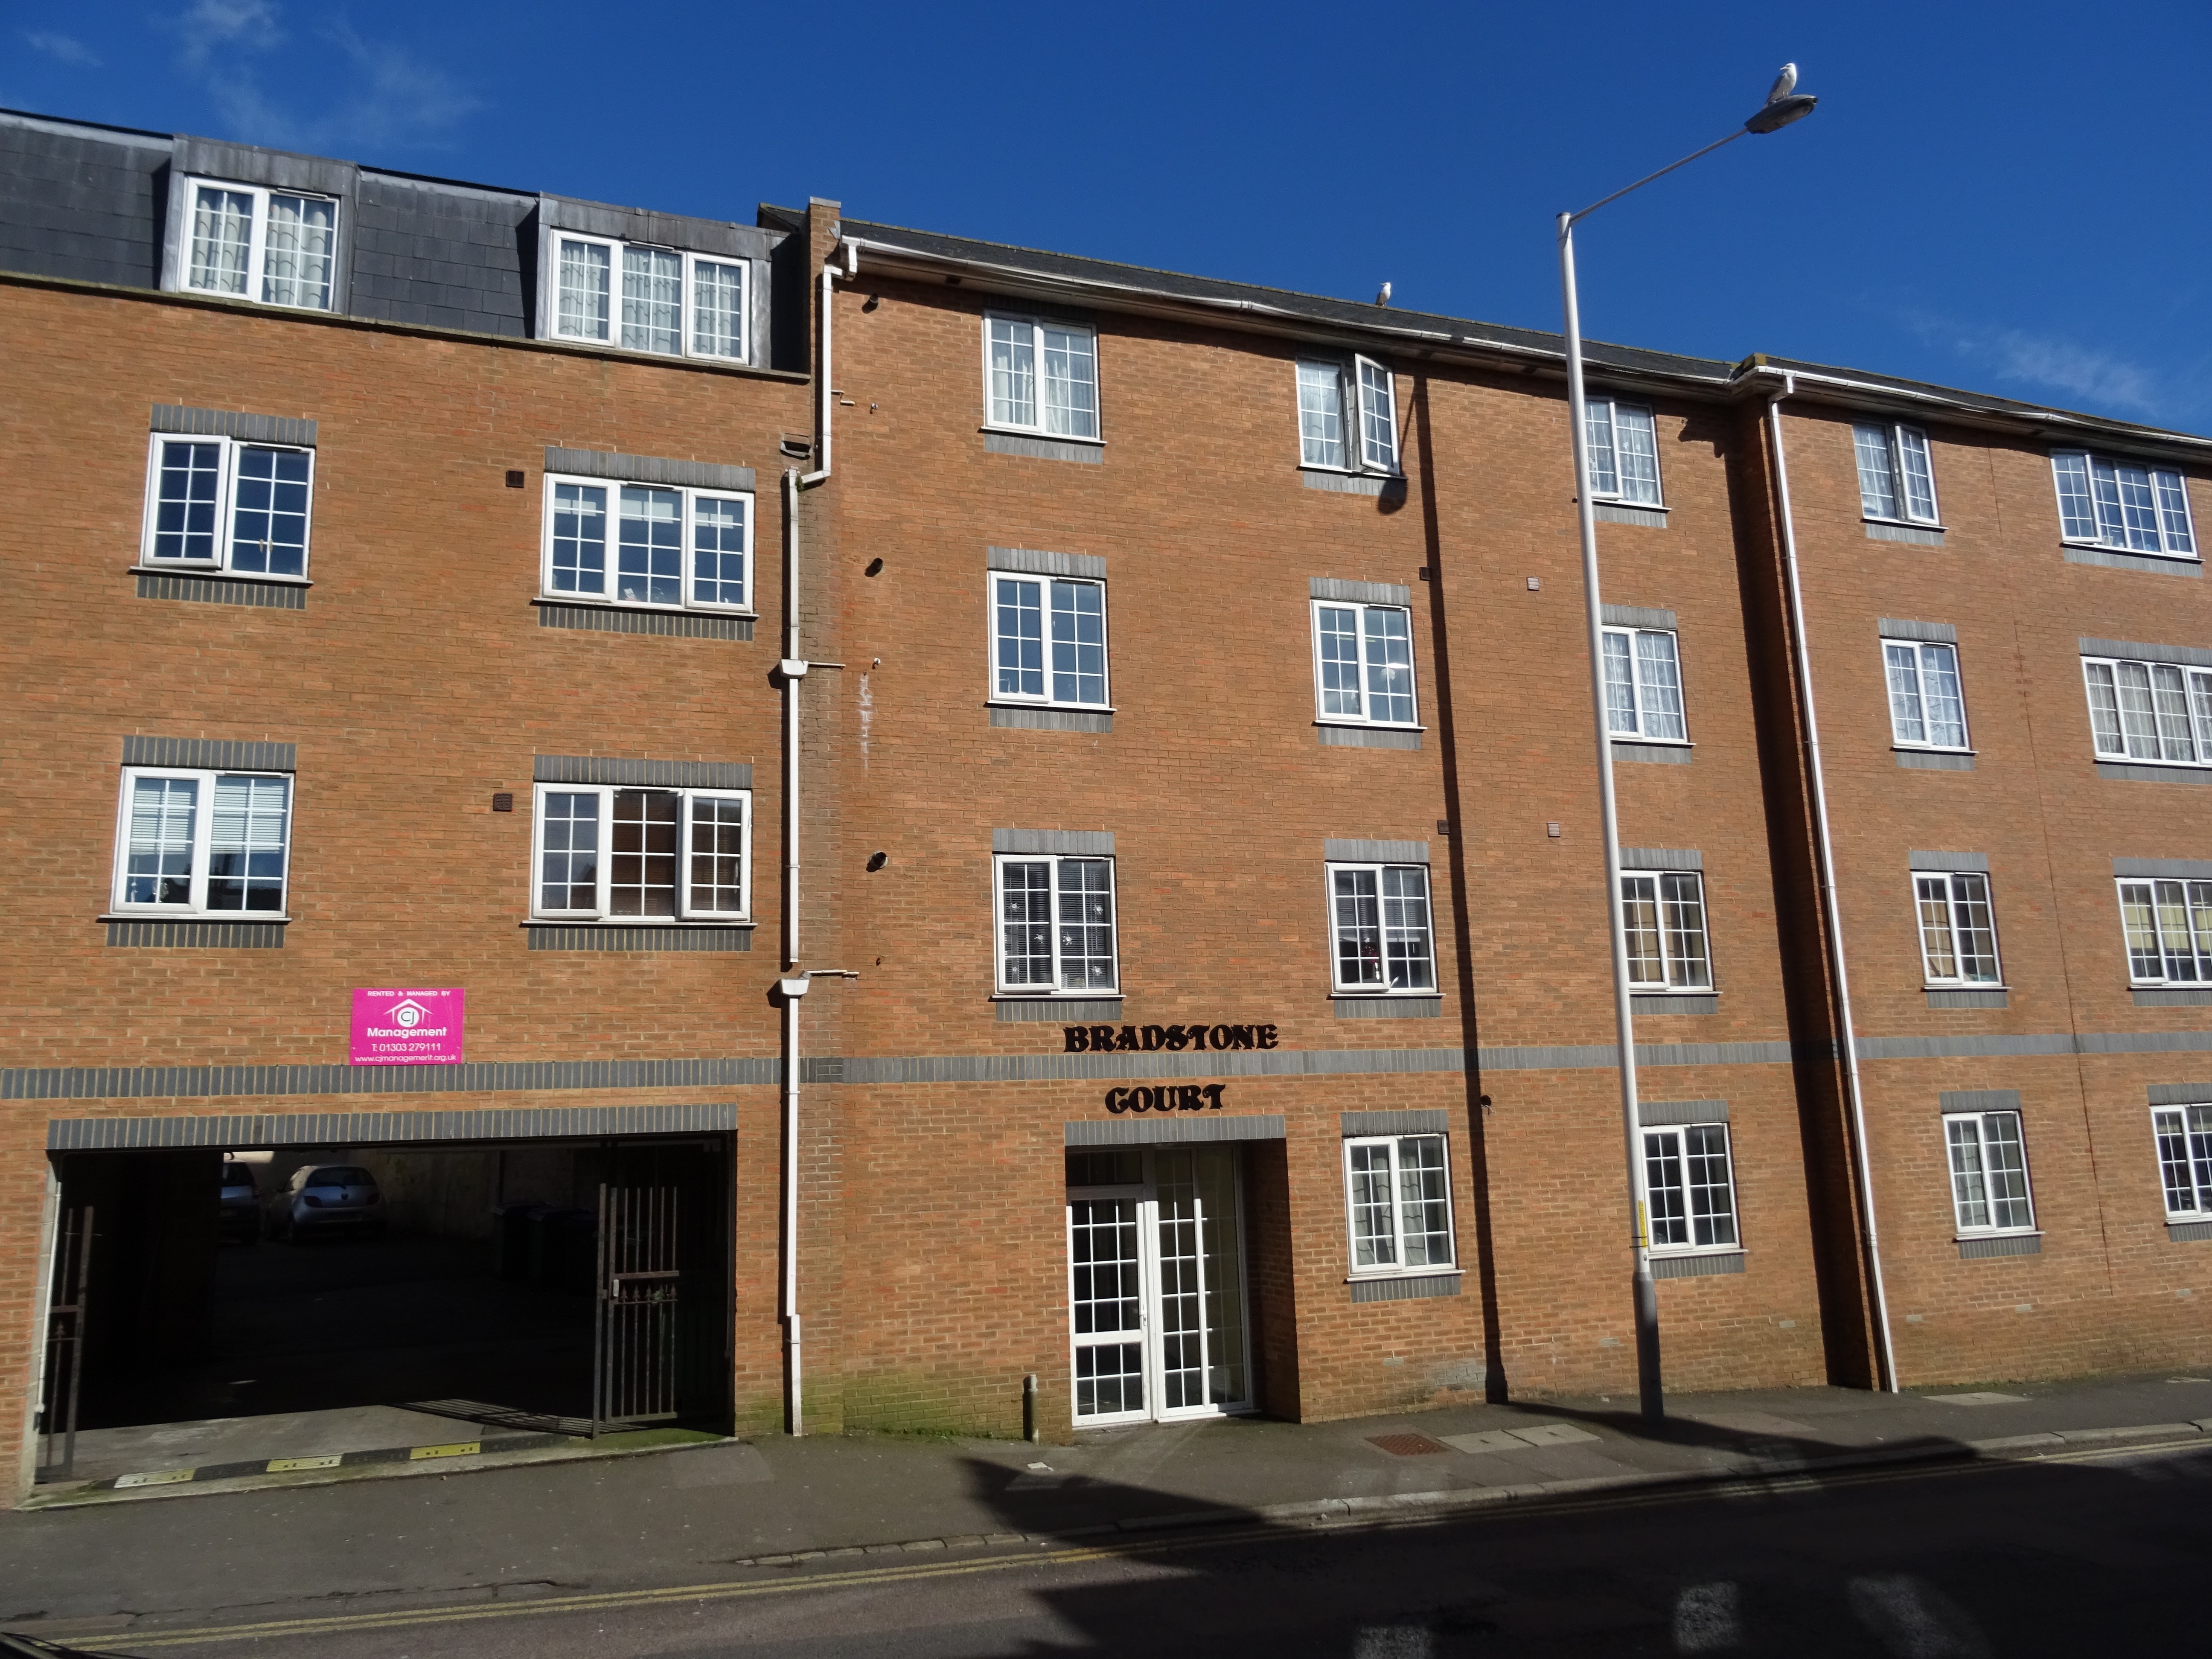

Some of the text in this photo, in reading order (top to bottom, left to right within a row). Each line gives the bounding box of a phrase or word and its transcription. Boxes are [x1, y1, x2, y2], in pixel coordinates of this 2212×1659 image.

[401, 1011, 415, 1025] CJ
[367, 1027, 447, 1039] Management
[1063, 1024, 1279, 1053] BRADSTONE
[379, 1043, 407, 1051] 01303
[408, 1043, 441, 1051] 279111
[355, 1054, 457, 1062] www.cjmanagement.org.uk
[1105, 1084, 1226, 1114] COURT
